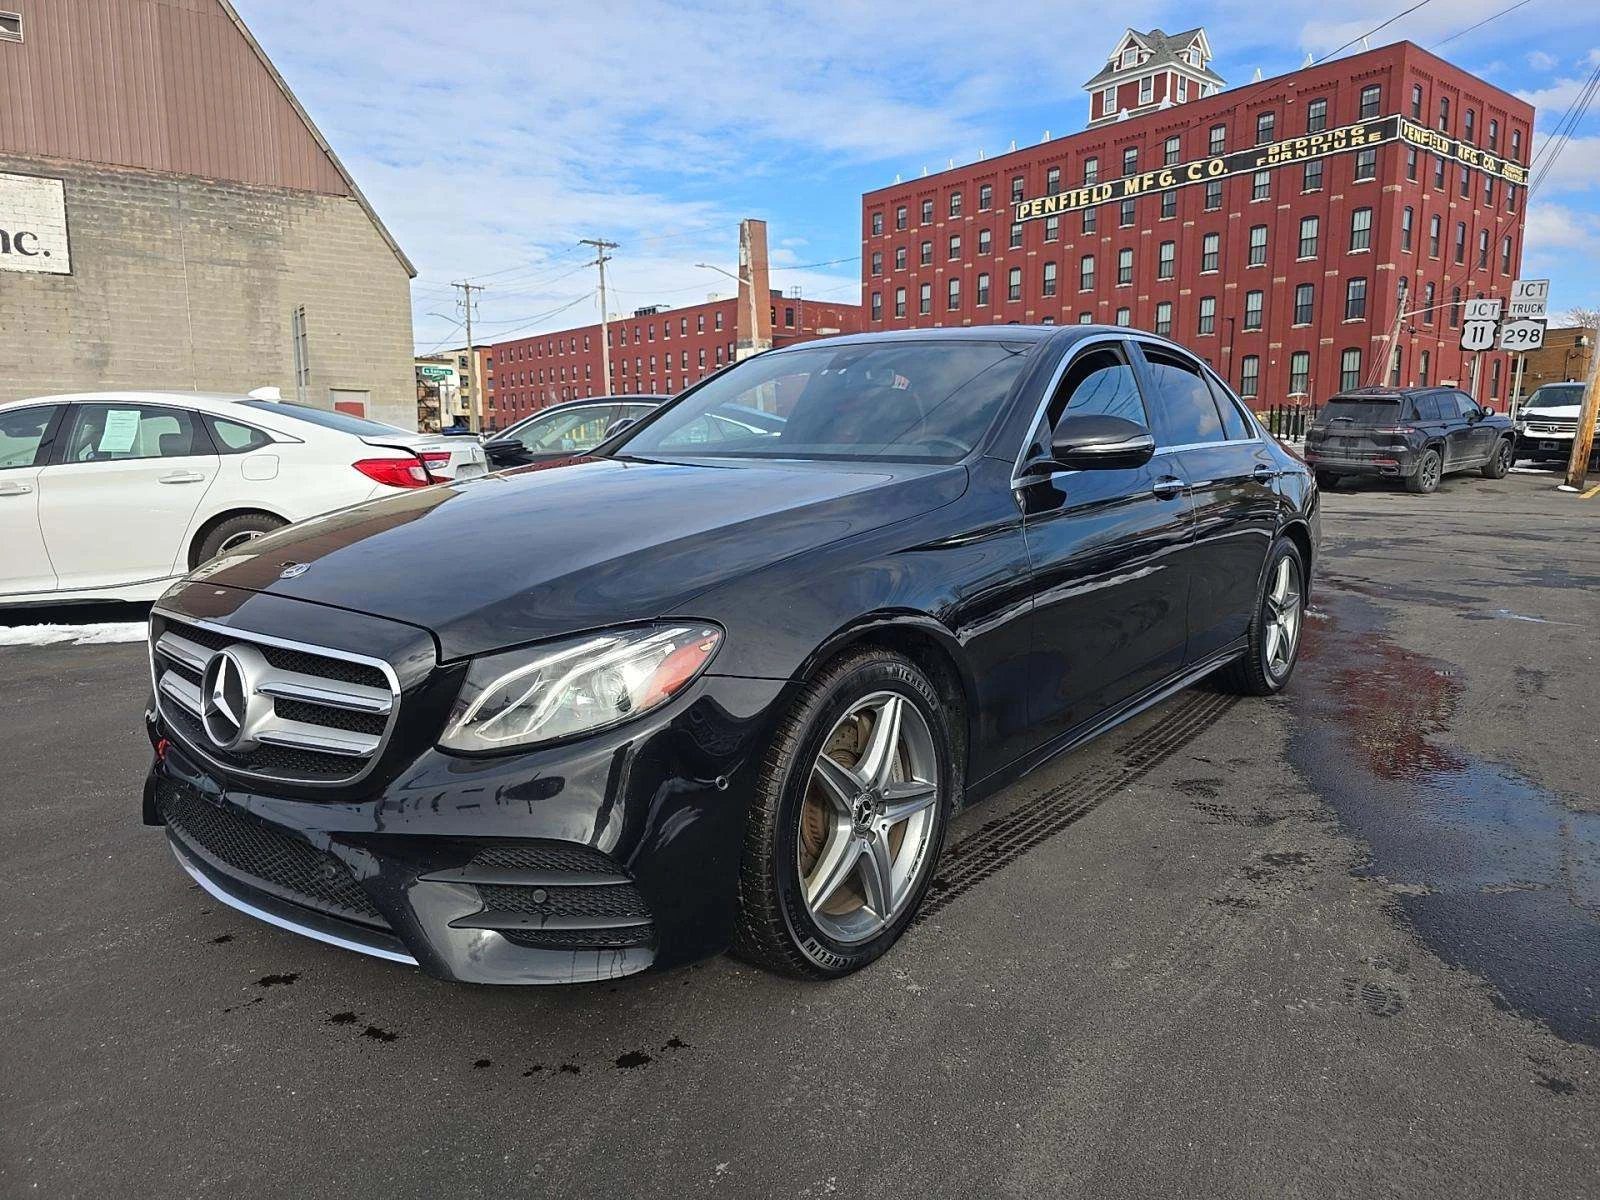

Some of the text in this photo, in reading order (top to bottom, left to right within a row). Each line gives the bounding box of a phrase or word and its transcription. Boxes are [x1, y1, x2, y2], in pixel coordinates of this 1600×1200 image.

[1267, 125, 1366, 155] BEDDING
[1256, 131, 1382, 167] FURNITURE
[1019, 158, 1229, 219] PENFIELD MFG. CO.
[1515, 282, 1547, 297] JCT
[1468, 303, 1498, 316] JCT
[1512, 303, 1544, 314] TRUCK
[1472, 326, 1486, 343] 11
[1503, 329, 1540, 343] 298
